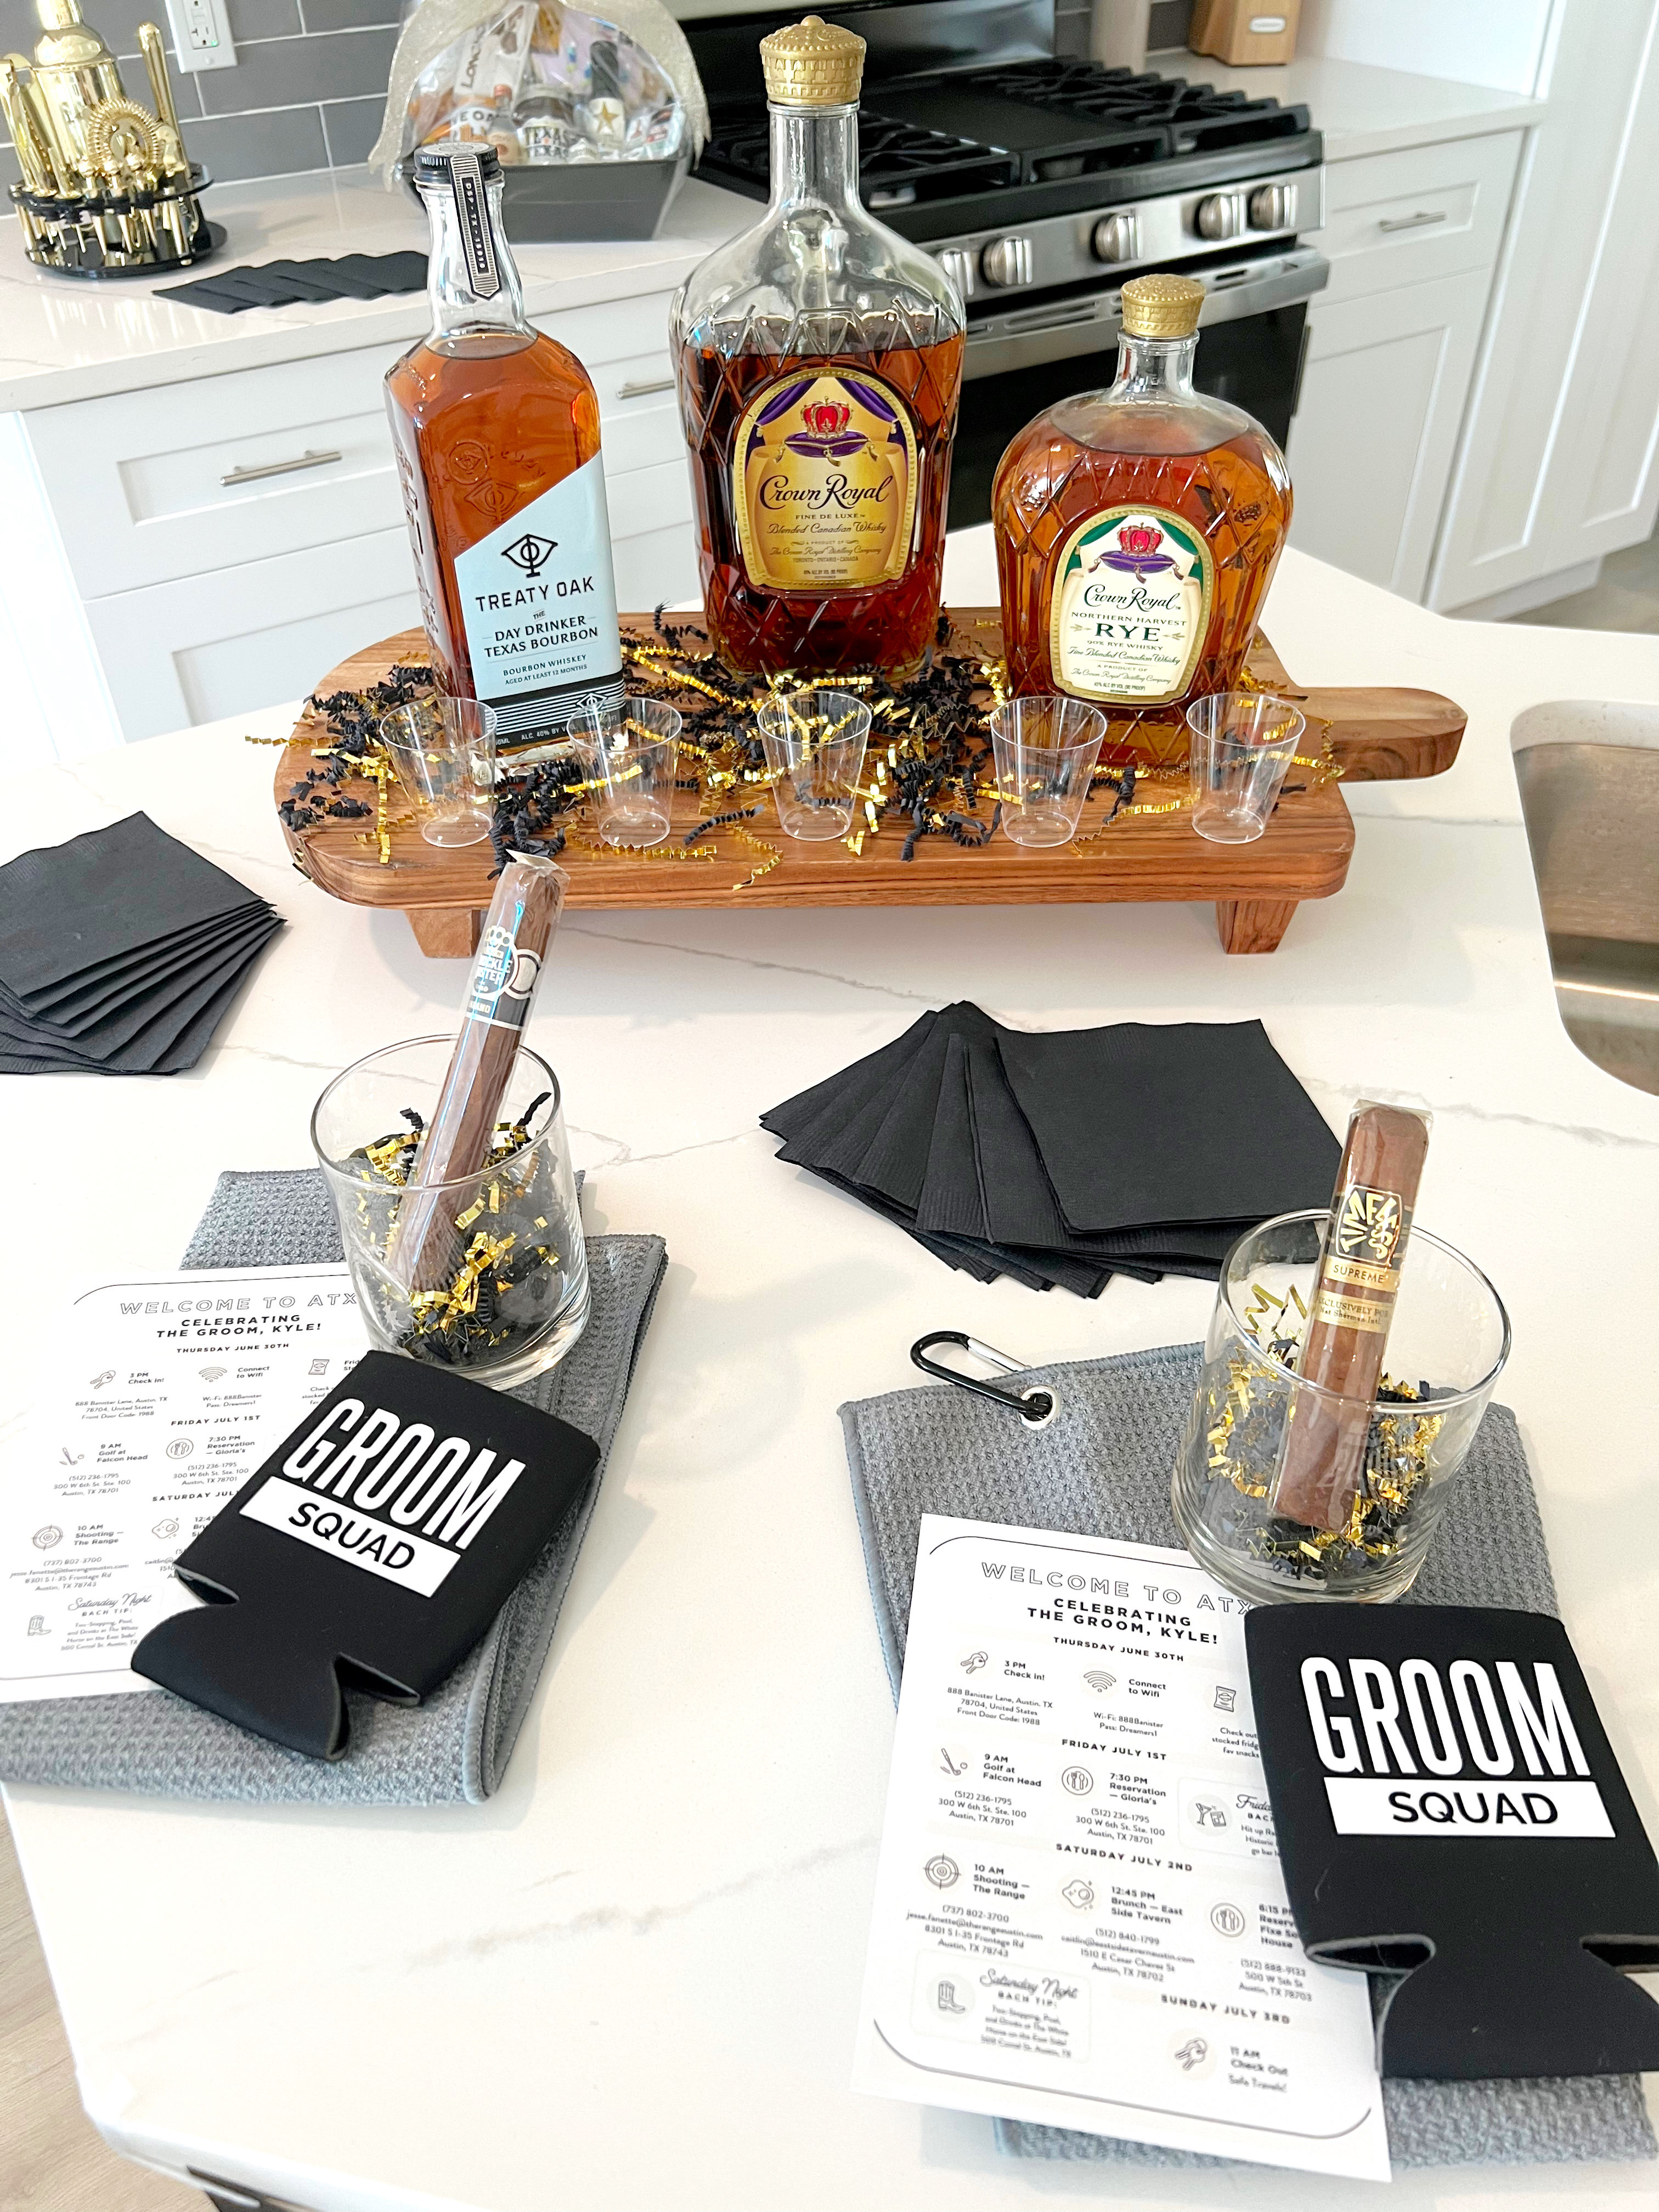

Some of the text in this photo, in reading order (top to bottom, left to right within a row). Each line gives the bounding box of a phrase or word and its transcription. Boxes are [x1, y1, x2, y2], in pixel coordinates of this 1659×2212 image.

[760, 473, 893, 510] Crown Royal
[766, 521, 887, 534] Blended Canadian Whisky
[476, 576, 594, 612] TREATY OAK
[1084, 584, 1181, 612] Crown Royal
[533, 611, 545, 620] THE
[1071, 611, 1187, 627] NORTHERN HARVEST
[495, 615, 586, 641] DAY DRINKER
[1094, 623, 1161, 642] RYE
[484, 627, 598, 657] TEXAS BOURBON
[1067, 646, 1181, 665] Fine Blended Canadian Whisky
[503, 654, 586, 676] BOURBON WHISKEY
[505, 676, 523, 685] AGED
[533, 671, 551, 679] LEAST
[560, 664, 588, 674] MONTHS
[1333, 1265, 1384, 1283] SUPREME
[120, 1293, 357, 1314] WELCOME TO ATX
[181, 1314, 301, 1327] CELEBRATING
[156, 1323, 321, 1338] THE GROOM, KYLE!
[282, 1398, 527, 1550] GROOM
[152, 1492, 211, 1502] SATURDAY
[289, 1502, 415, 1570] SQUAD
[981, 1561, 1252, 1615] WELCOME TO ATX
[67, 1593, 153, 1611] Saturday Night
[1054, 1598, 1191, 1626] CELEBRATING
[1027, 1607, 1217, 1644] THE GROOM, KYLE!
[1054, 1637, 1184, 1662] THURSDAY JUNE 30TH
[1004, 1669, 1031, 1679] Check
[1129, 1679, 1166, 1690] Connect
[1141, 1689, 1159, 1697] Wifi
[964, 1689, 993, 1700] Banister
[995, 1694, 1014, 1703] Lane,
[957, 1707, 1040, 1725] Front Door Code: 1988
[961, 1699, 1038, 1716] 78704, United States
[1300, 1656, 1591, 1776] GROOM
[1099, 1722, 1117, 1731] Pass:
[1220, 1727, 1243, 1736] Check
[1062, 1739, 1167, 1760] FRIDAY JULY 1ST
[1212, 1737, 1239, 1746] stocked
[984, 1763, 1003, 1771] Golf
[983, 1772, 1041, 1787] Falcon Head
[1110, 1773, 1147, 1785] 7:30 PM
[955, 1790, 1012, 1805] (512) 236-1795
[1110, 1782, 1166, 1797] Reservation
[938, 1798, 955, 1807] 300
[967, 1802, 980, 1811] 6th
[1012, 1809, 1026, 1818] 100
[1388, 1791, 1558, 1825] SQUAD
[949, 1810, 1014, 1826] Austin, TX 78701
[1056, 1843, 1192, 1871] SATURDAY JULY 2ND
[974, 1864, 1004, 1876] 10 AM
[973, 1874, 1018, 1889] Shooting
[972, 1883, 1025, 1900] The Range
[1140, 1891, 1155, 1900] PM
[1111, 1897, 1183, 1916] Brunch East
[1111, 1907, 1171, 1924] Side Tavern
[1161, 1993, 1257, 2019] SUNDAY JULY
